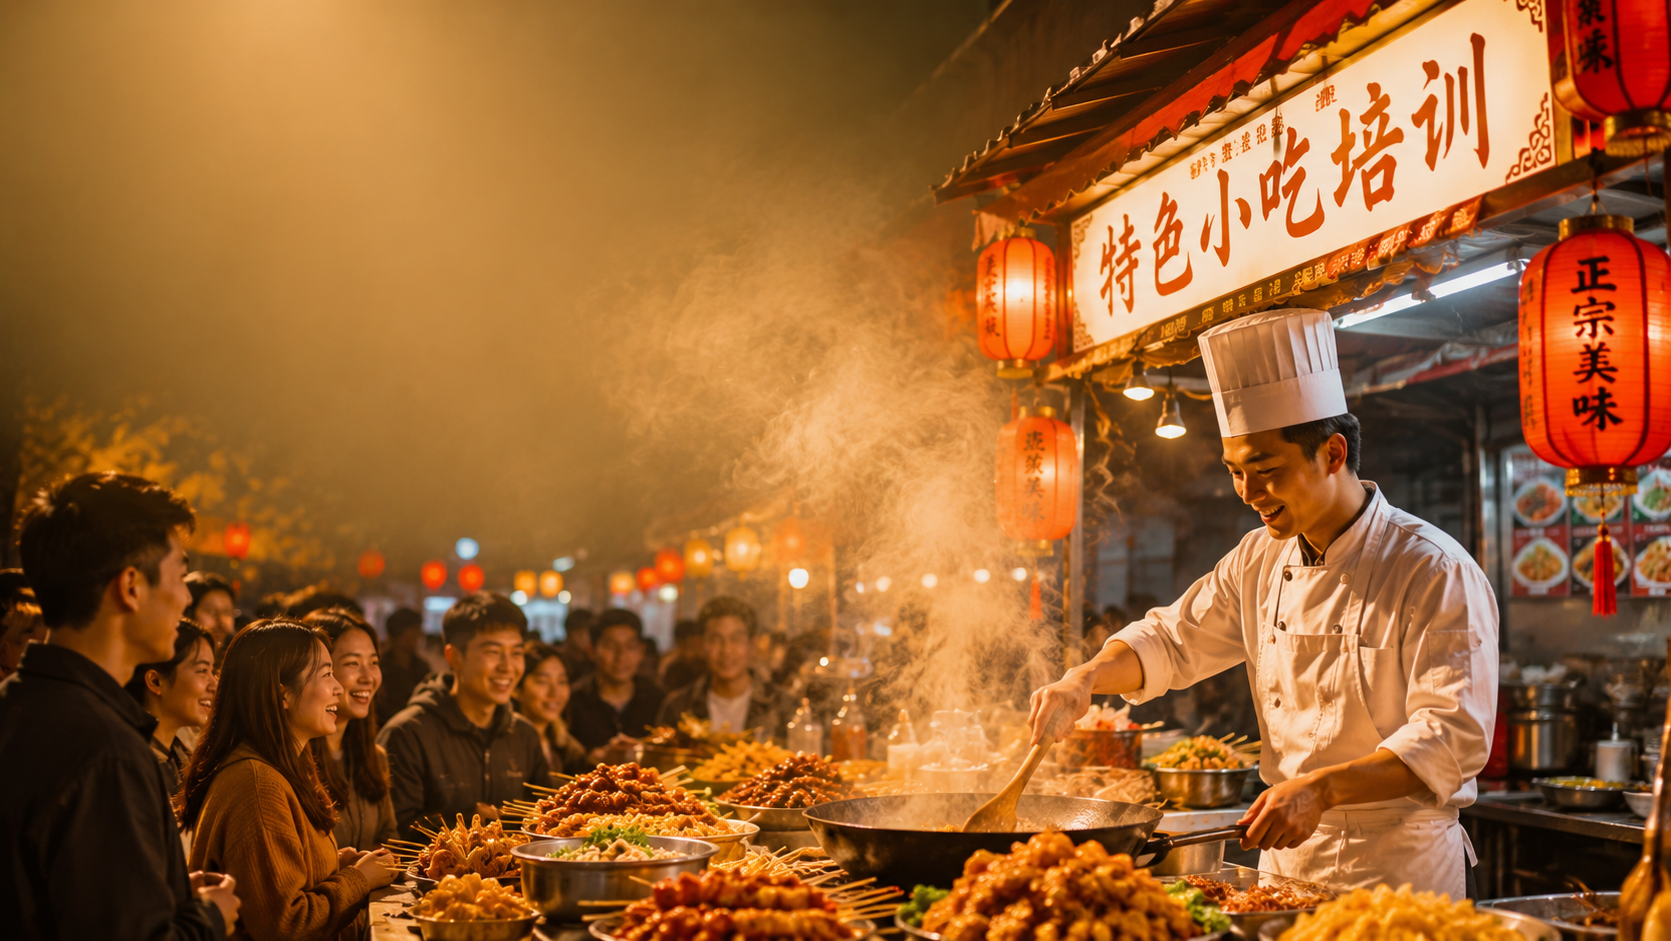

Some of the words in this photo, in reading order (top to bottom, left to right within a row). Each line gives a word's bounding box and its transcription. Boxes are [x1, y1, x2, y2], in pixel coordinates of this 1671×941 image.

[1100, 32, 1490, 317] 特色小吃培训
[1570, 256, 1623, 431] 正宗美味
